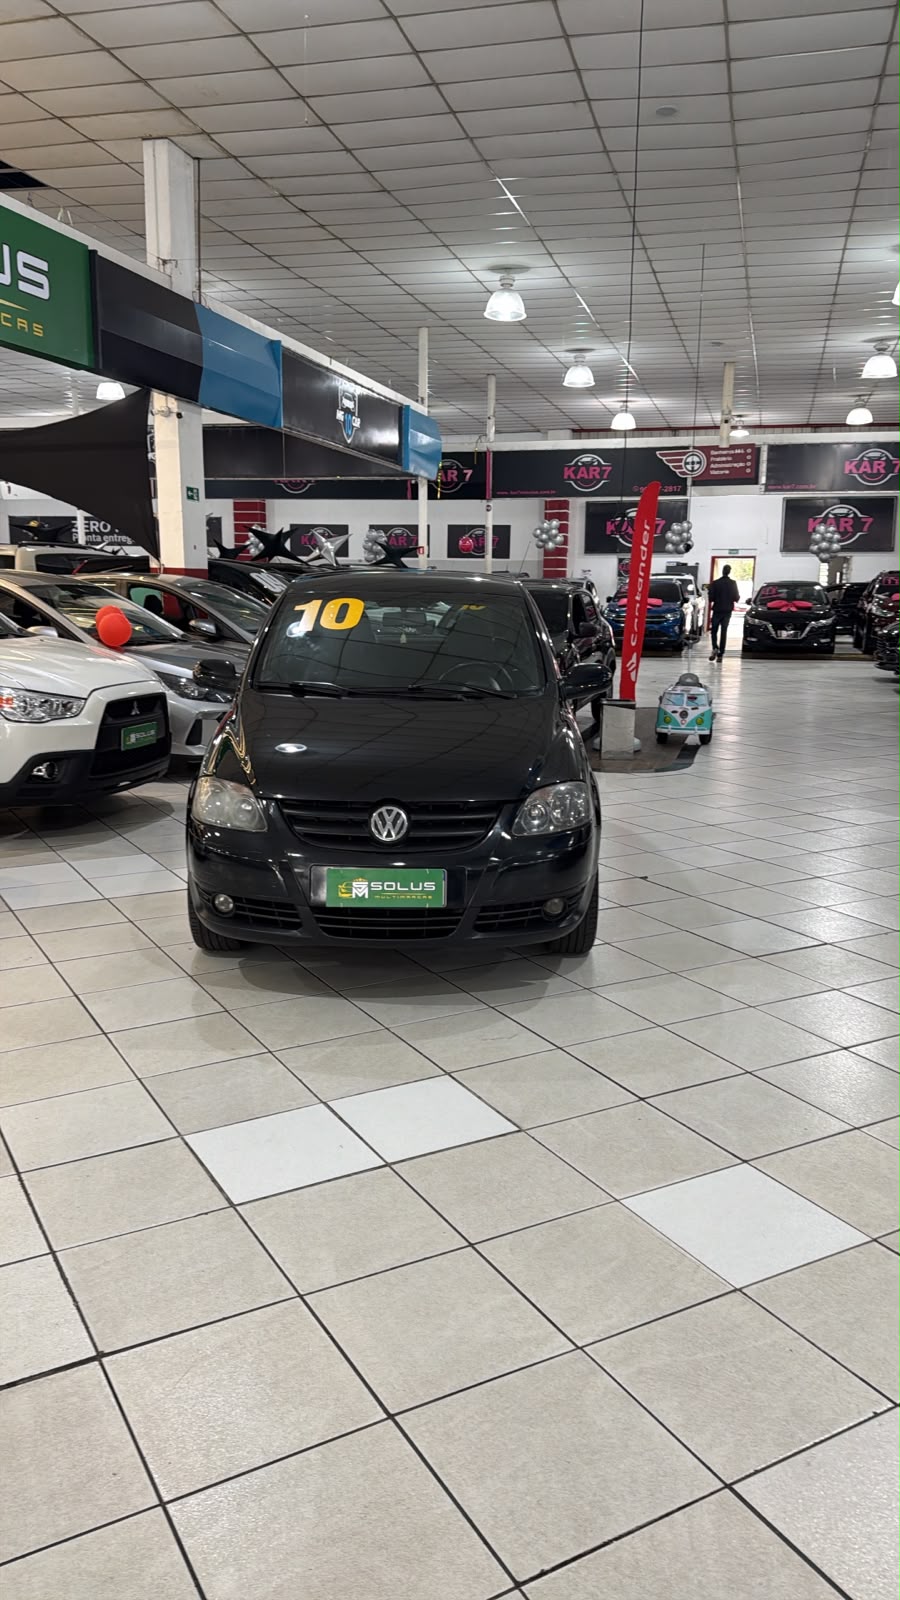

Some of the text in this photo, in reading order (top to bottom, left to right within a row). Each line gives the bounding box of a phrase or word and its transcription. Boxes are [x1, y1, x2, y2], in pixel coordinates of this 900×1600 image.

[463, 469, 473, 482] 7
[860, 518, 874, 532] 7
[294, 597, 365, 632] 10
[370, 881, 436, 890] SOLUS
